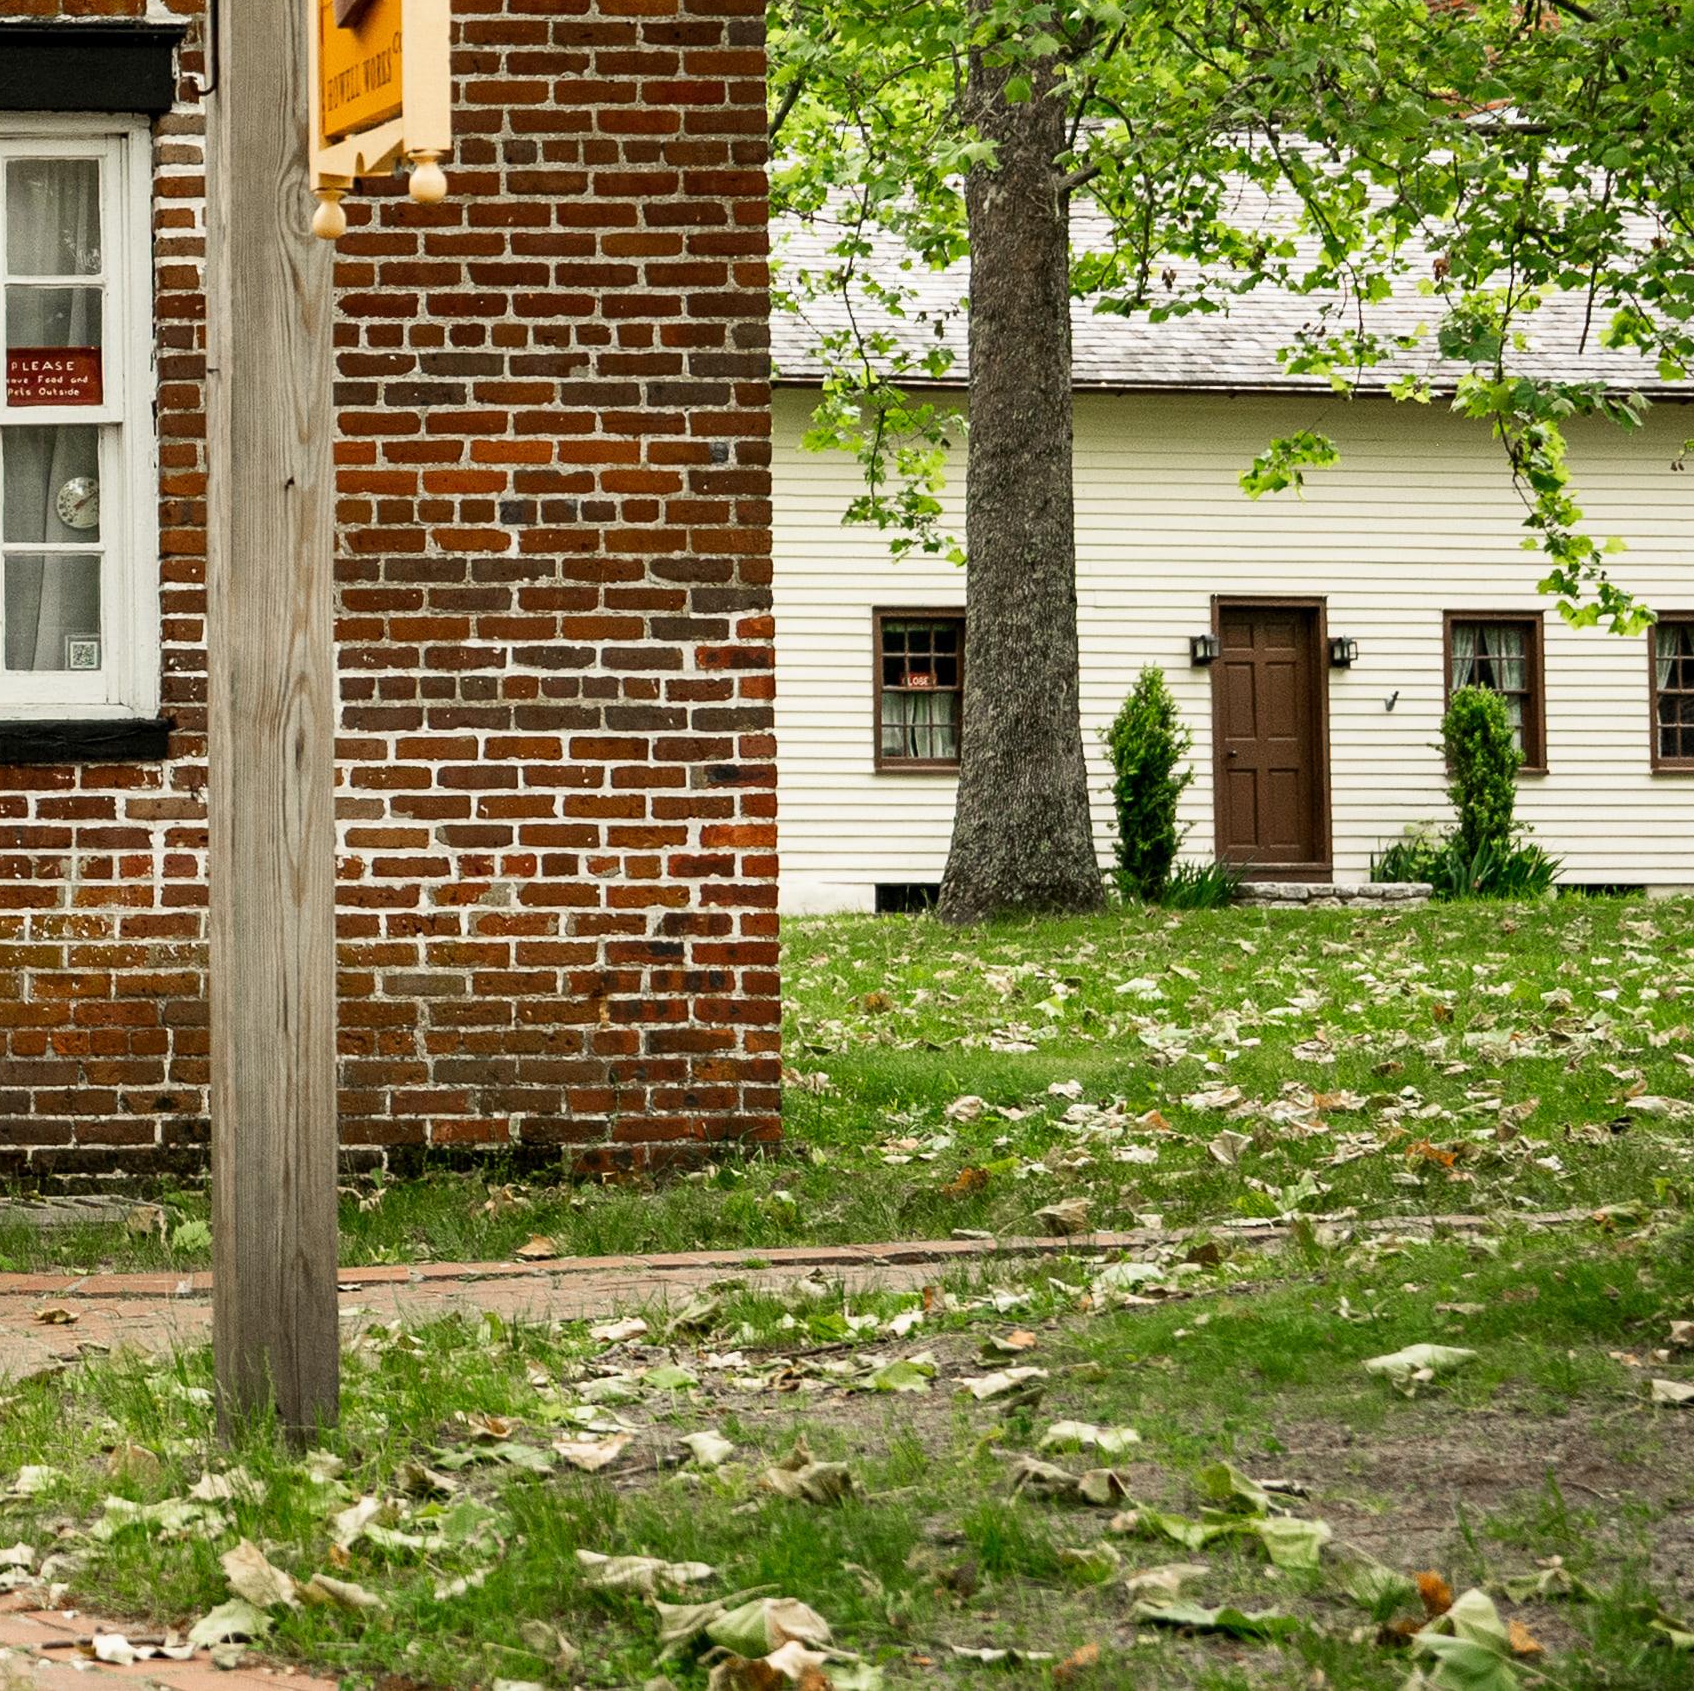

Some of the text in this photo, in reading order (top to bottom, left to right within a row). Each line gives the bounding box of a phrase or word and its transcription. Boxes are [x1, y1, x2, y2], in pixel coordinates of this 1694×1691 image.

[11, 361, 75, 371] PLEASE
[37, 375, 64, 383] Food
[38, 387, 80, 396] Outside
